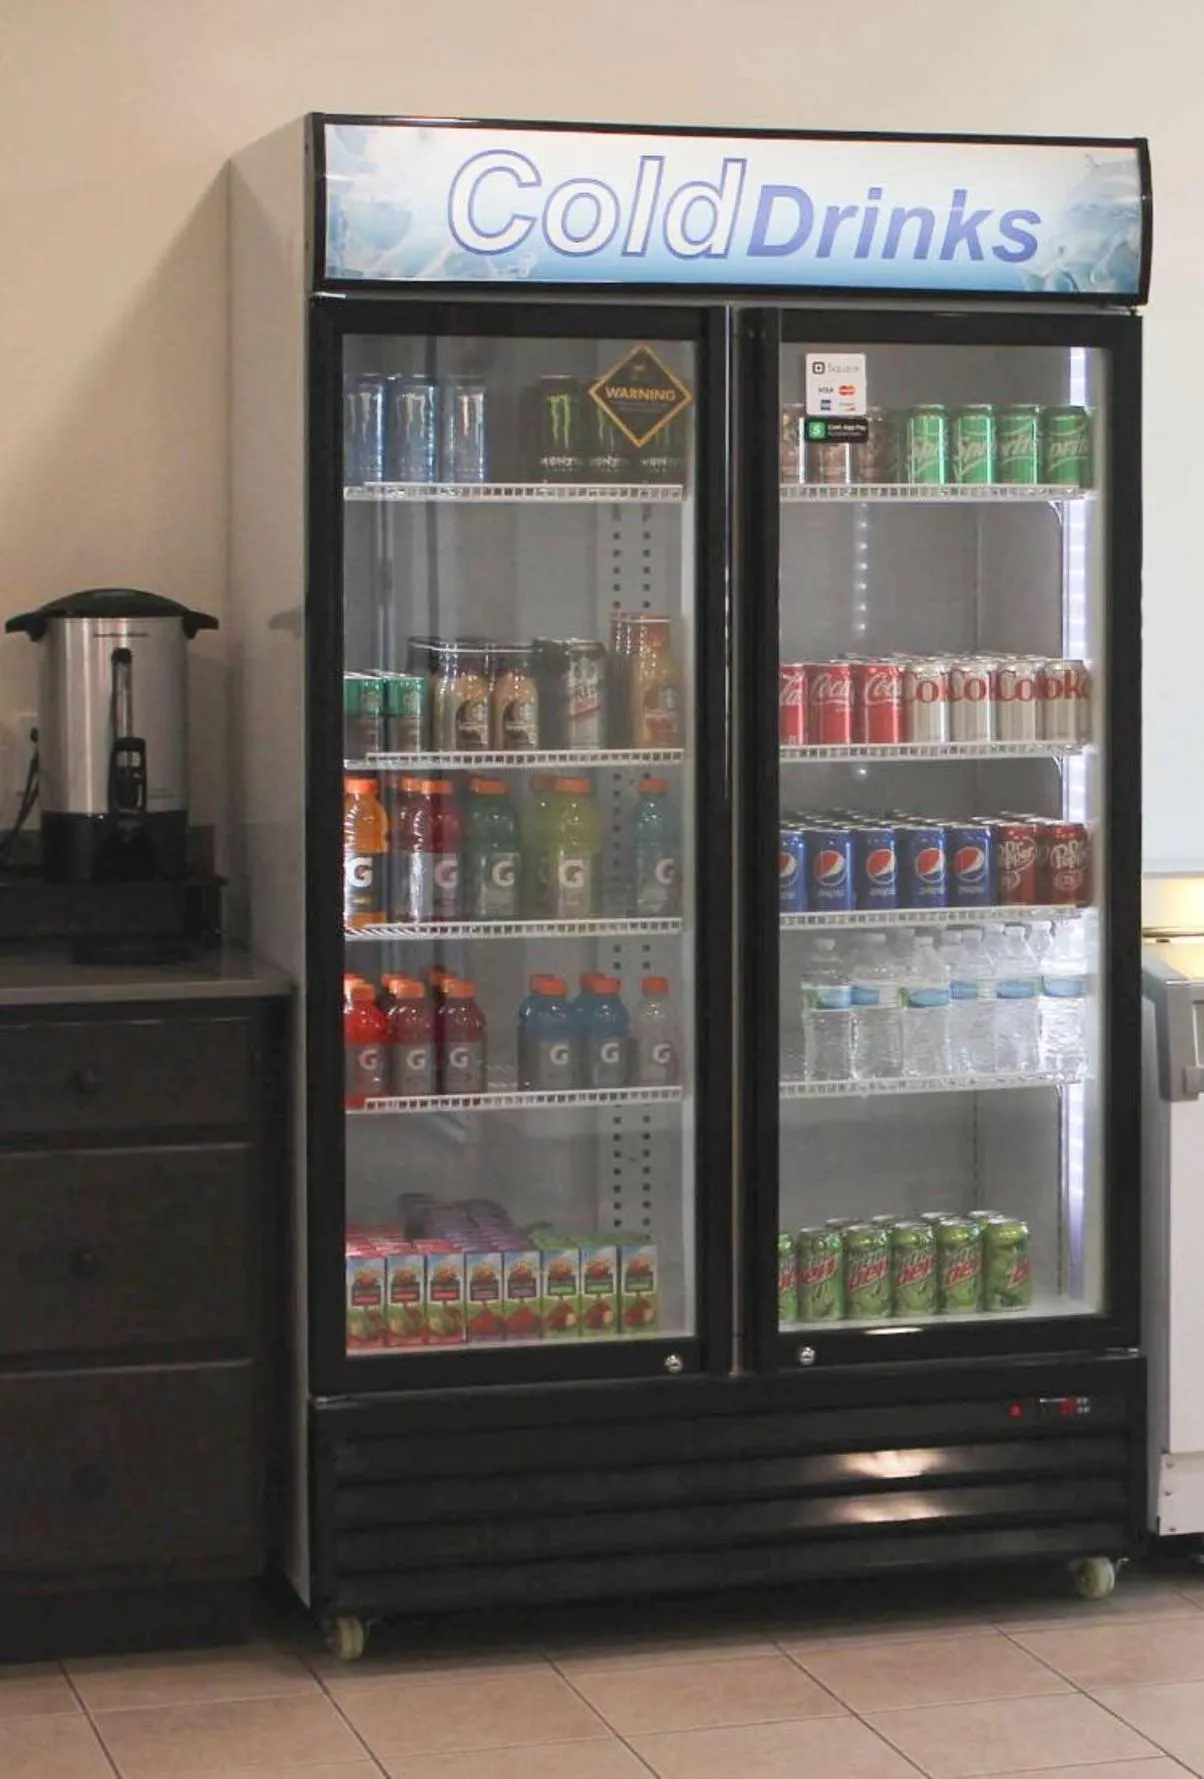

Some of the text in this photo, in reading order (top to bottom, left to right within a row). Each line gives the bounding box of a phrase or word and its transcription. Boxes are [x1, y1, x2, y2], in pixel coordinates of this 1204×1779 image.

[447, 148, 1042, 264] Cold Drinks
[605, 386, 677, 401] WARNING
[349, 857, 373, 888] G
[435, 860, 458, 889] G
[492, 861, 514, 887] G
[558, 859, 584, 888] G
[360, 1050, 378, 1070] G
[406, 1049, 426, 1069] G
[450, 1048, 469, 1069] G
[550, 1045, 569, 1065] G
[601, 1043, 620, 1063] G
[653, 1043, 670, 1063] G
